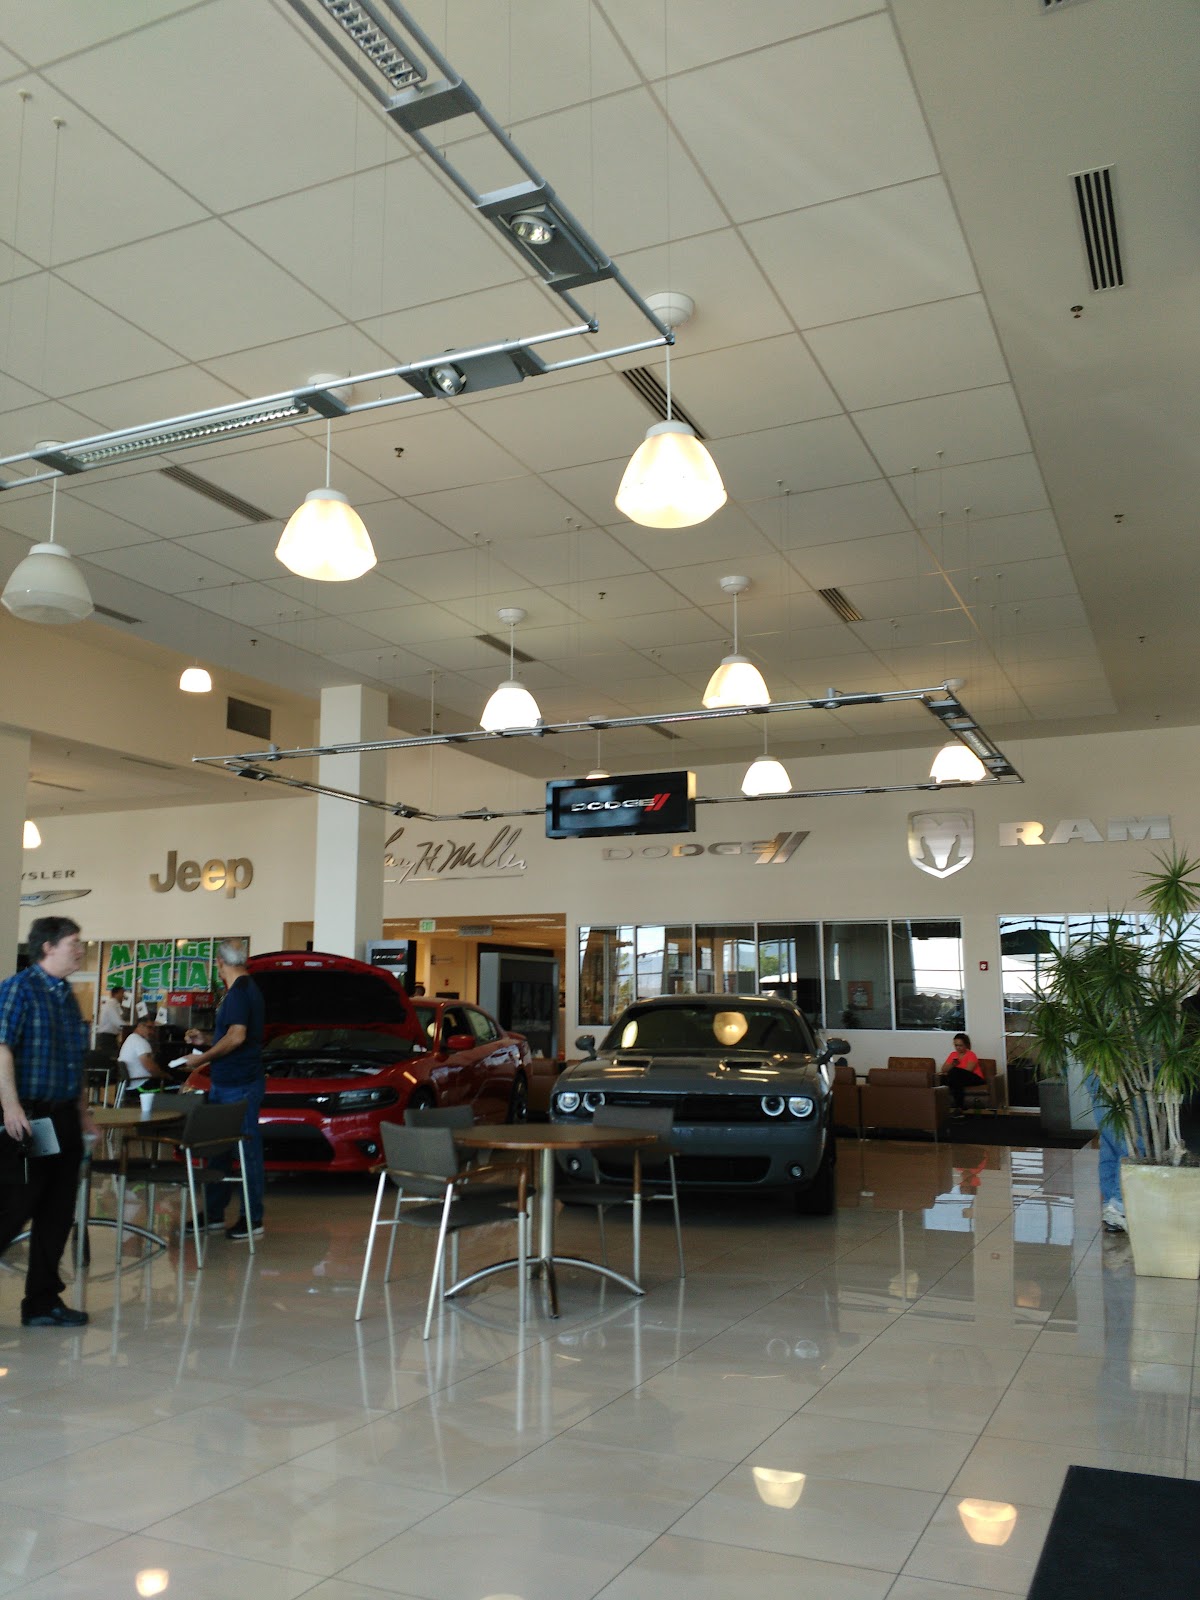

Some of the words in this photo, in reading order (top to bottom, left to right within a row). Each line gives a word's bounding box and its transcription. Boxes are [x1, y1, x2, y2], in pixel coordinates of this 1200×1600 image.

[570, 799, 655, 812] DODGE
[998, 814, 1171, 847] RAM
[439, 824, 528, 874] Miller
[602, 840, 777, 861] DODGE
[149, 850, 254, 899] Jeep
